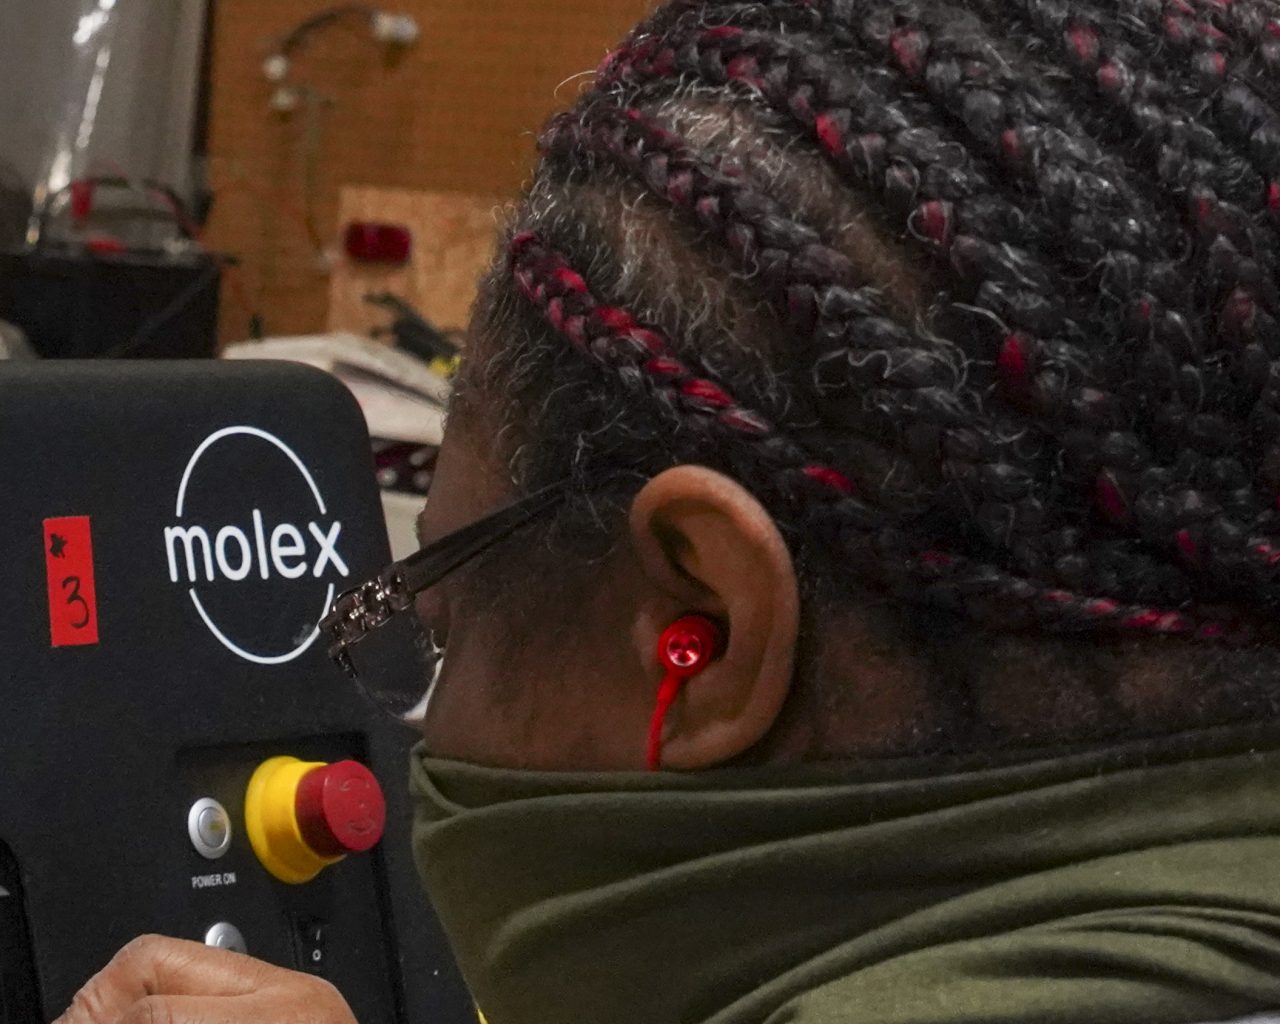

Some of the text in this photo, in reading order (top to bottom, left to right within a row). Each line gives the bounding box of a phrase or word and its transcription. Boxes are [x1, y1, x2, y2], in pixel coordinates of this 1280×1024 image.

[164, 509, 349, 582] molex
[62, 575, 90, 629] 3
[191, 872, 236, 889] POWER ON
